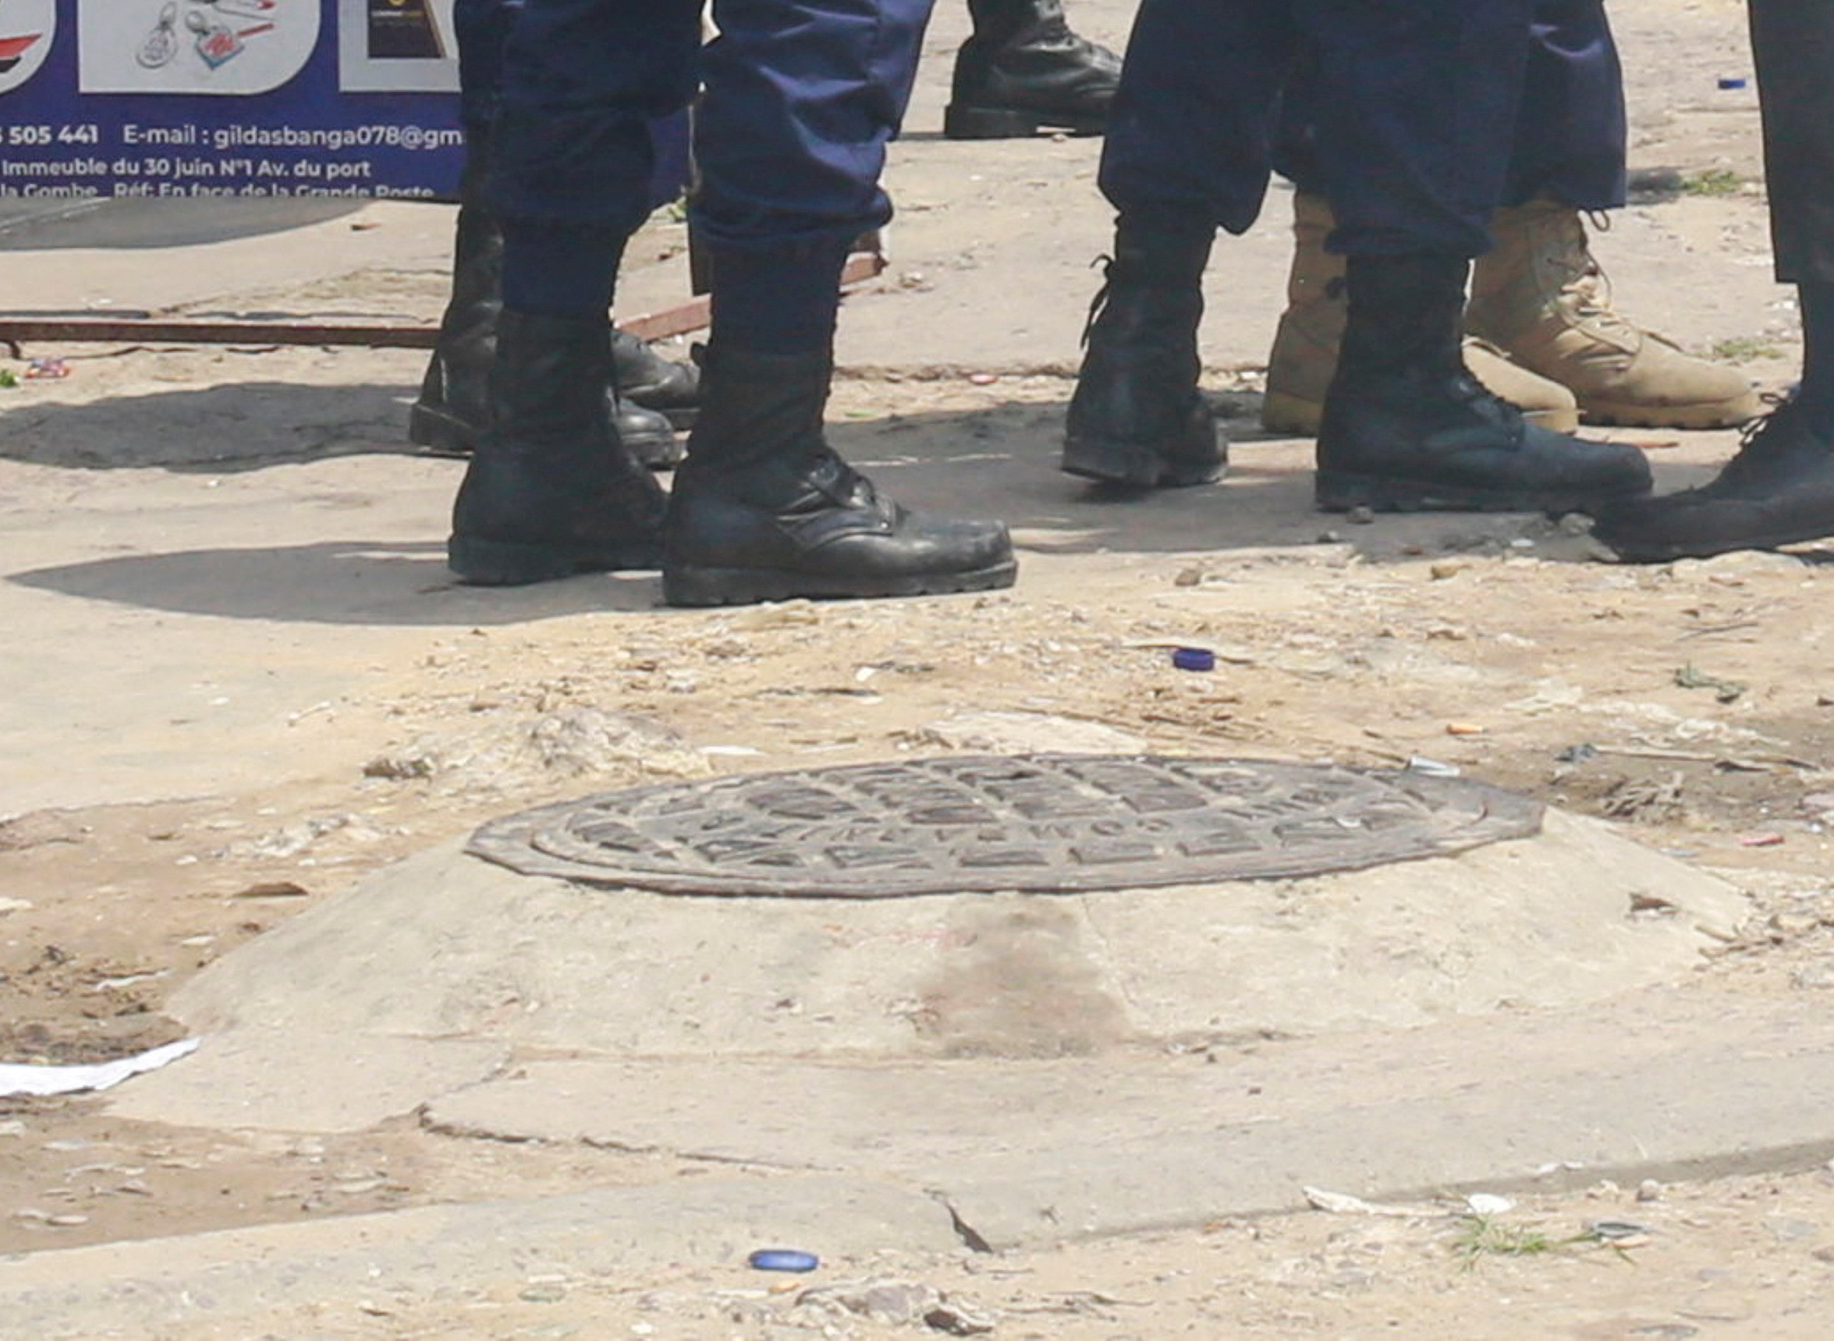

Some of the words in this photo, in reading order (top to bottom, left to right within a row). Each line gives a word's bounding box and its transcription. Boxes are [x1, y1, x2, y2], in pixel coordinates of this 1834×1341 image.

[8, 125, 53, 145] 505
[57, 124, 99, 144] 441
[123, 124, 196, 145] E-mail
[2, 157, 107, 176] Immeuble
[111, 157, 140, 176] du
[144, 158, 170, 176] 30
[173, 157, 215, 179] juin
[257, 158, 289, 177] Av.
[293, 158, 321, 177] du
[325, 159, 372, 181] port
[0, 182, 18, 197] la
[23, 181, 99, 198] Gombe
[159, 181, 186, 198] En
[190, 182, 234, 198] face
[239, 183, 267, 198] de
[271, 183, 292, 198] la
